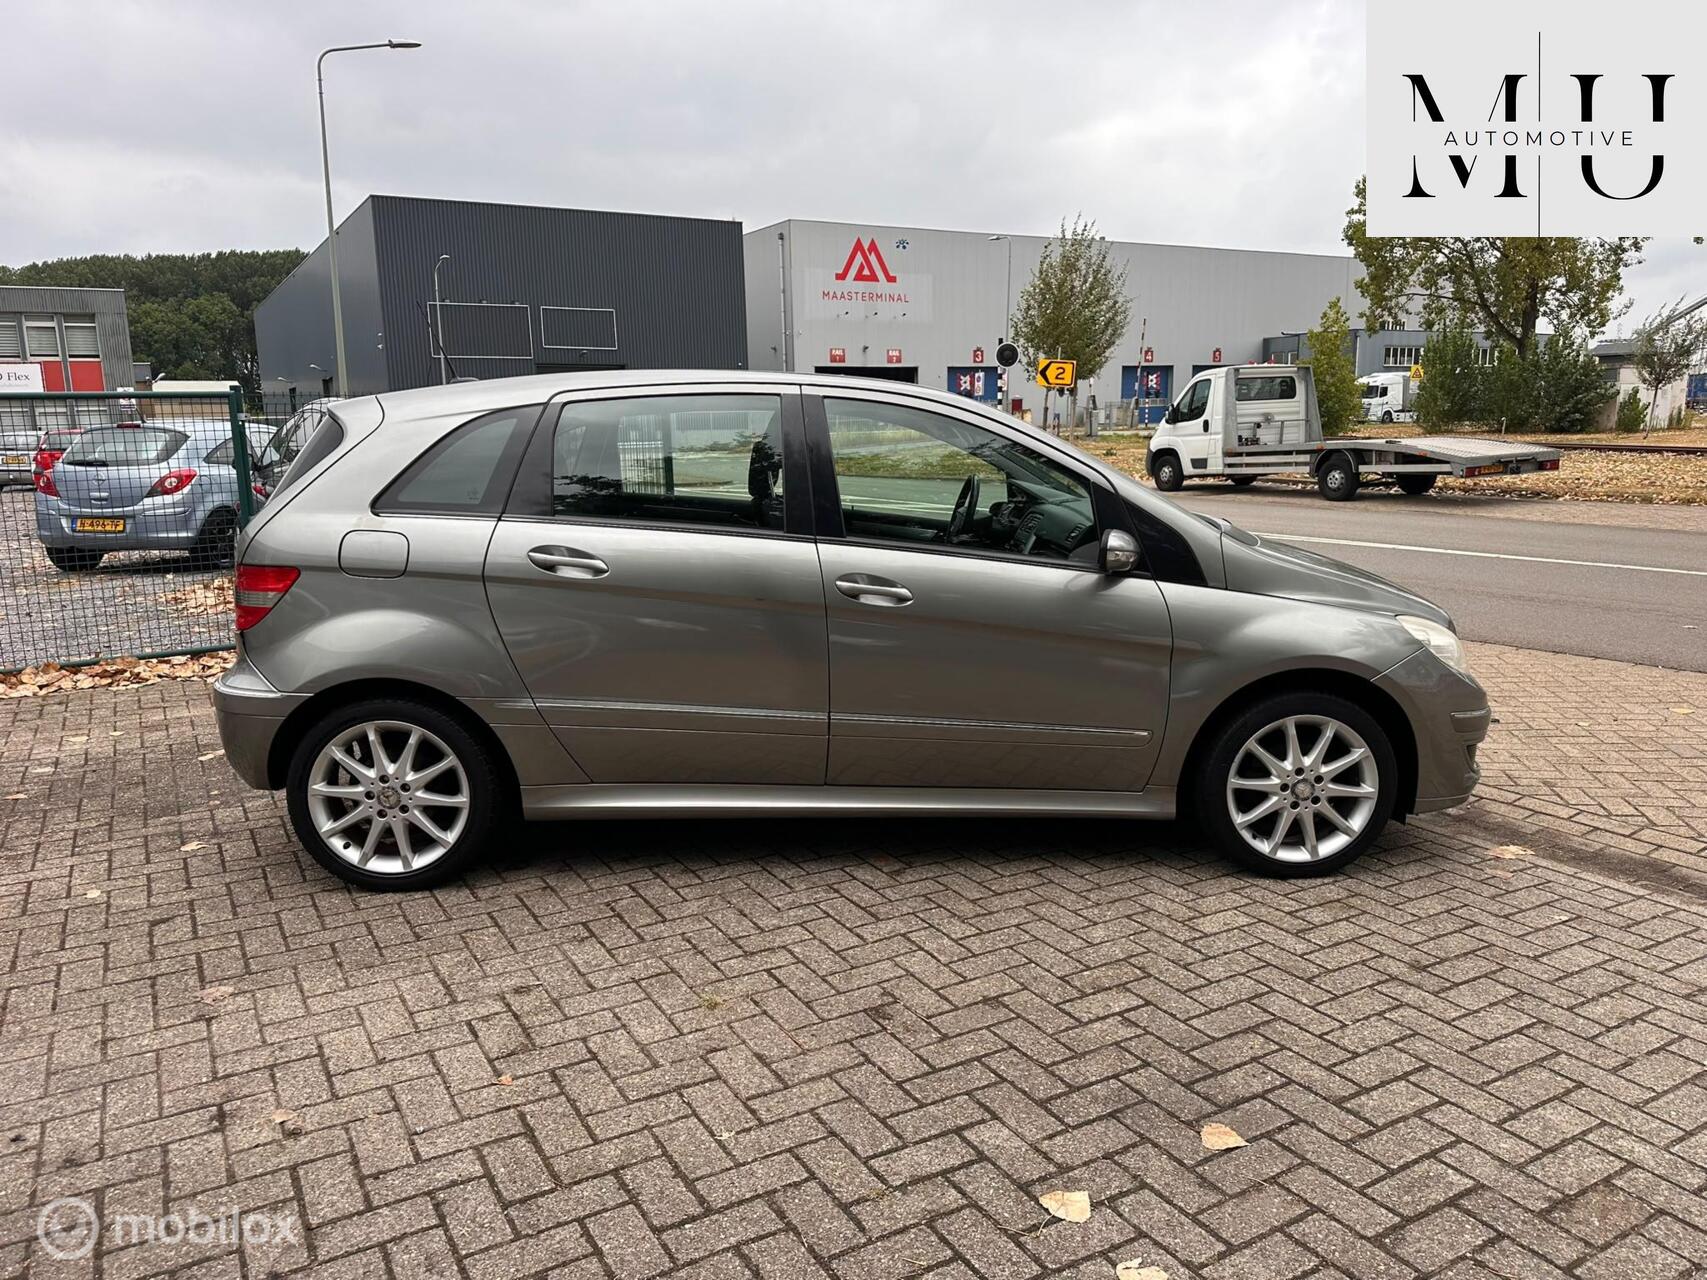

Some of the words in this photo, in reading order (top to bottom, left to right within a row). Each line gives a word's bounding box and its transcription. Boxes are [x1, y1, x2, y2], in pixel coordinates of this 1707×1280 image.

[822, 290, 909, 303] MAASTERMINAL
[975, 351, 982, 362] 3
[1145, 351, 1152, 361] 4
[7, 372, 30, 381] Flex
[1055, 366, 1066, 380] 2
